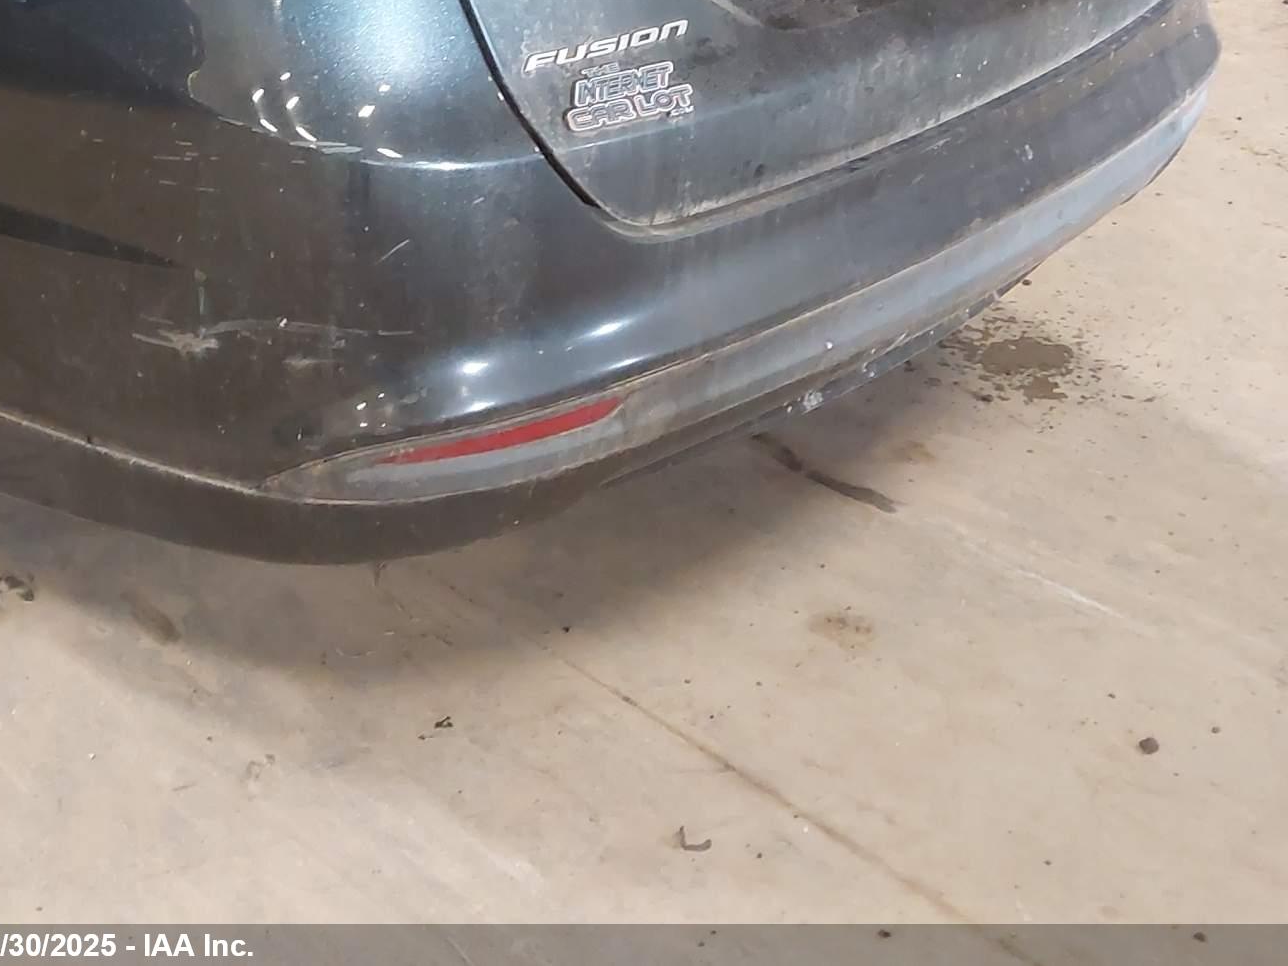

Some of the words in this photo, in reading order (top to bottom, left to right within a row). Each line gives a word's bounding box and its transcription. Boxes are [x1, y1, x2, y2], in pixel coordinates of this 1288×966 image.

[523, 19, 689, 74] FUSION
[567, 99, 637, 131] CAR
[633, 83, 693, 117] LOT
[574, 61, 674, 107] INTERNET
